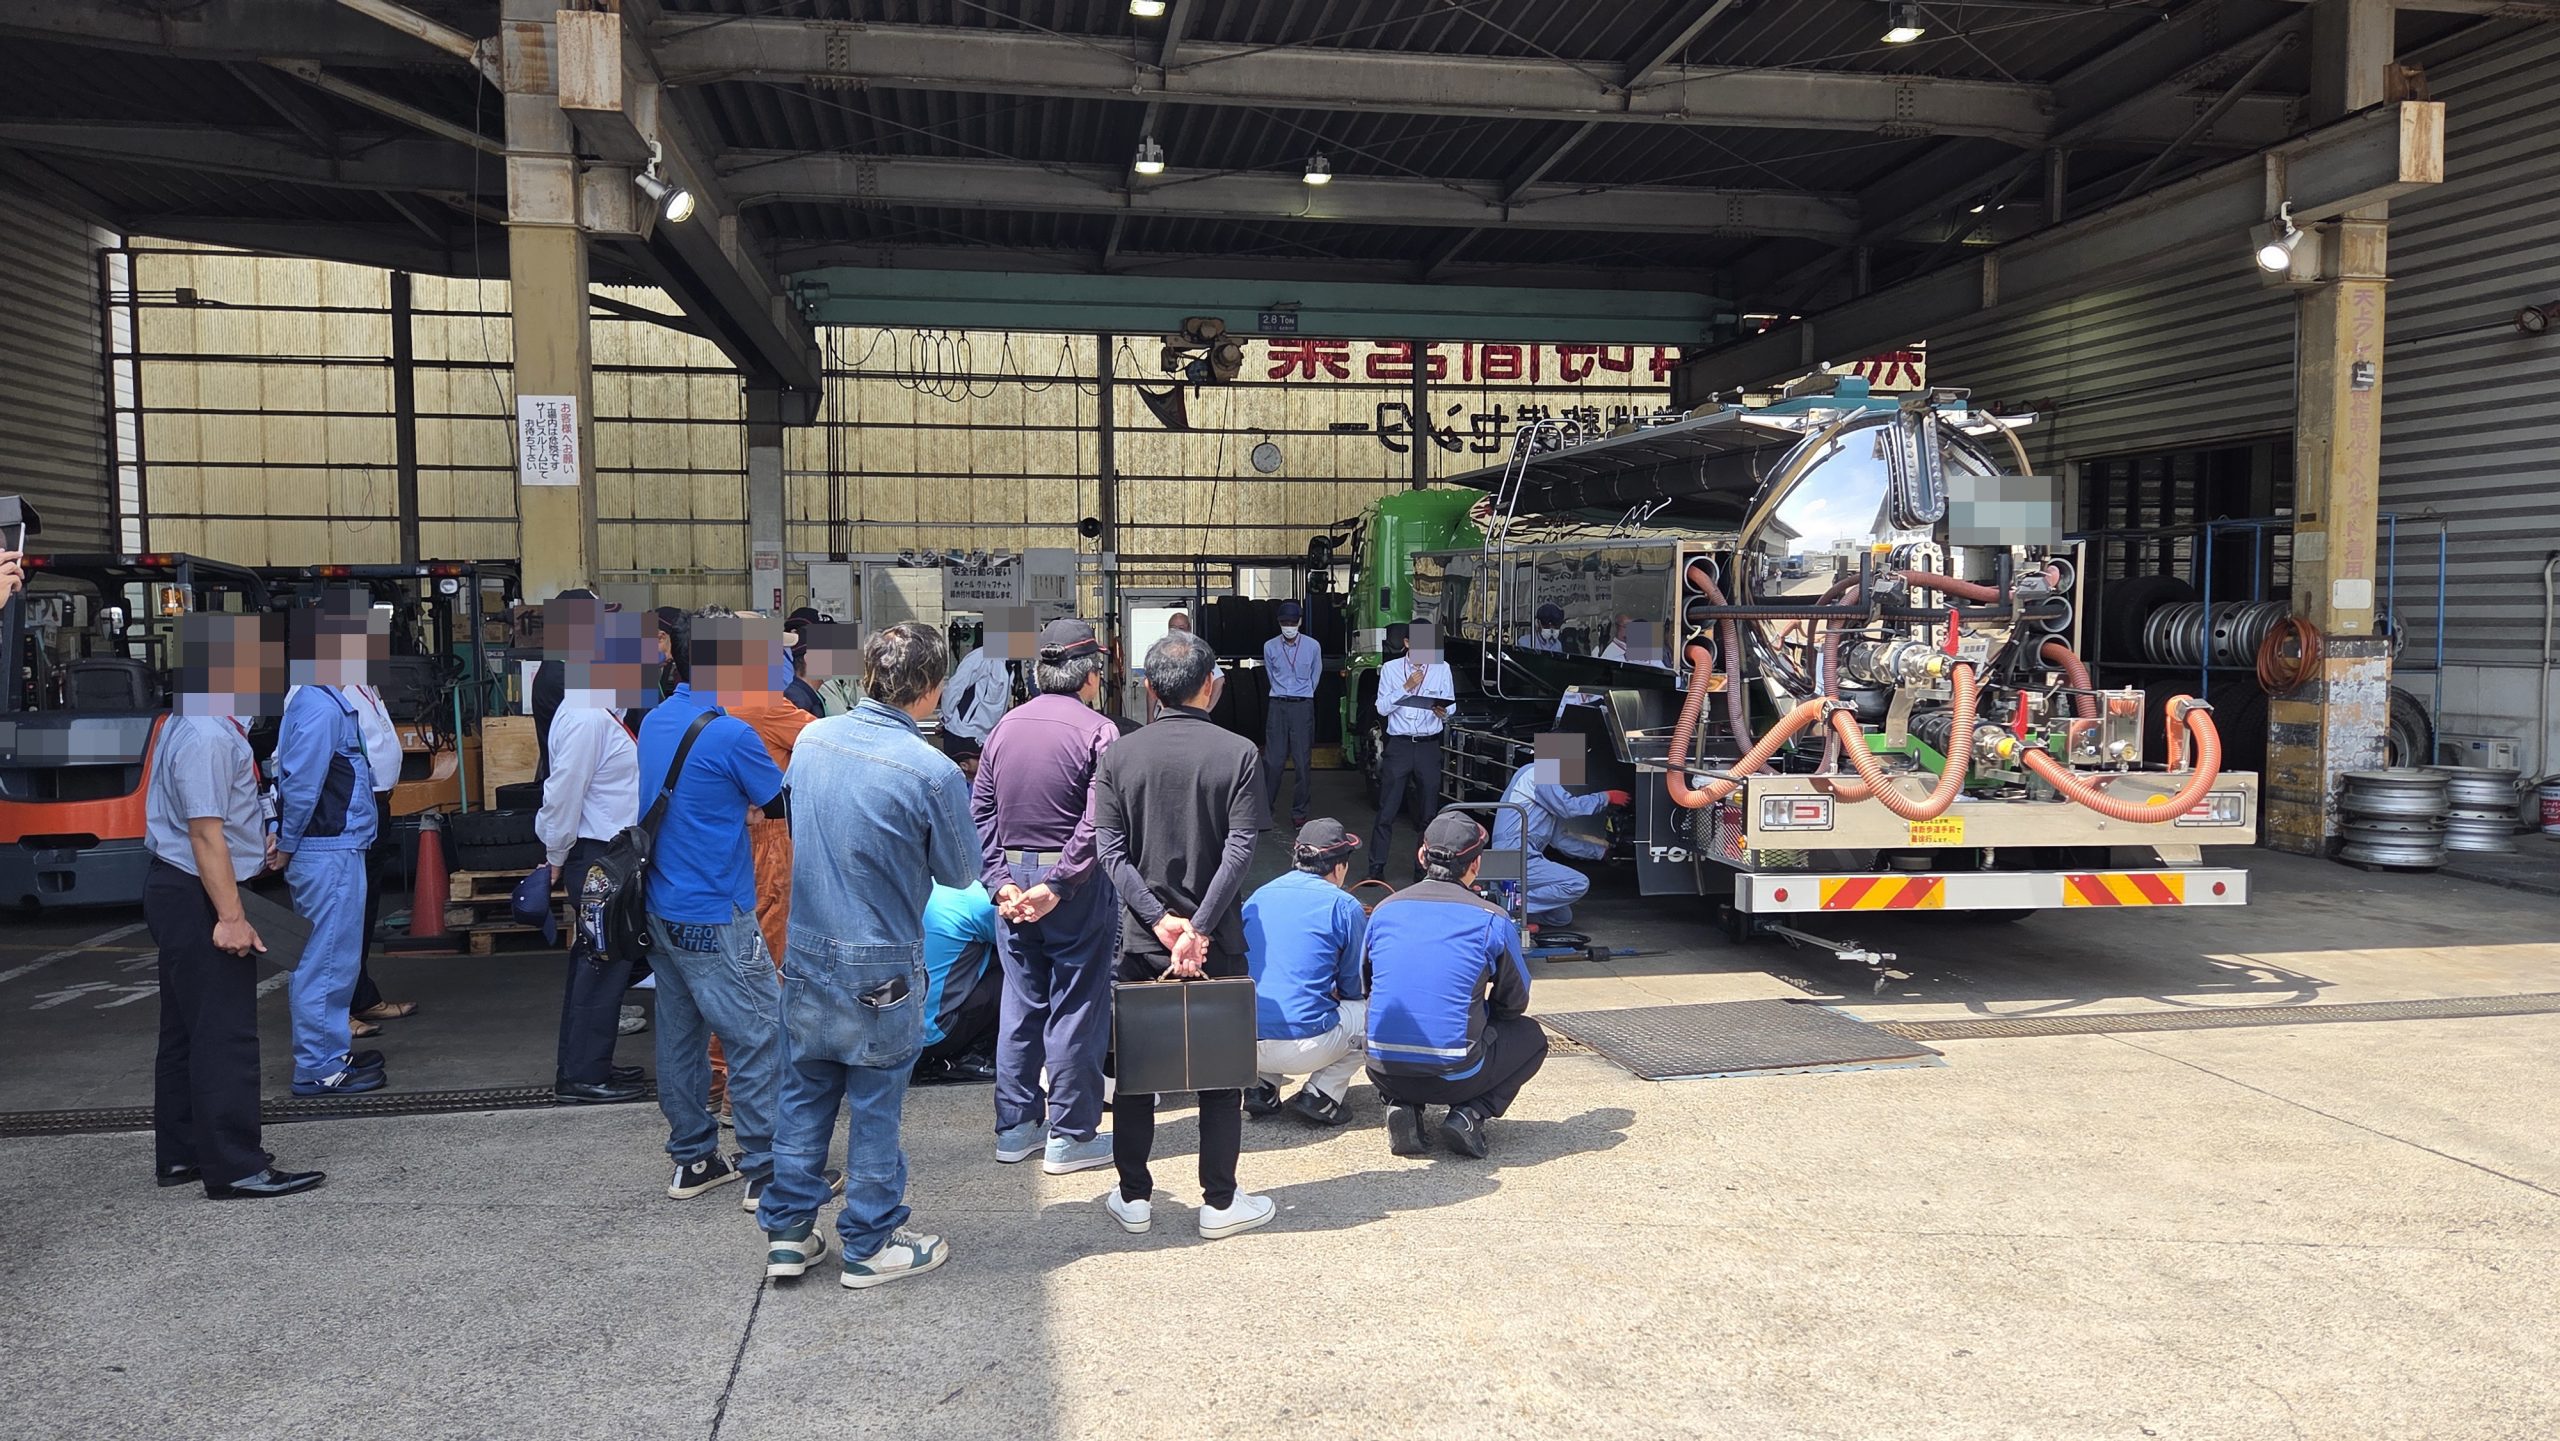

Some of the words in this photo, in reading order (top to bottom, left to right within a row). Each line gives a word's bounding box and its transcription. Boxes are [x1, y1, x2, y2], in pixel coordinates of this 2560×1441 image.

[525, 419, 537, 470] お待ち下さい
[536, 402, 549, 479] サービスルームにて
[547, 402, 560, 471] 工場内は危険です
[560, 402, 575, 474] お客様へお願い
[951, 566, 1011, 576] 安全行動の誓い
